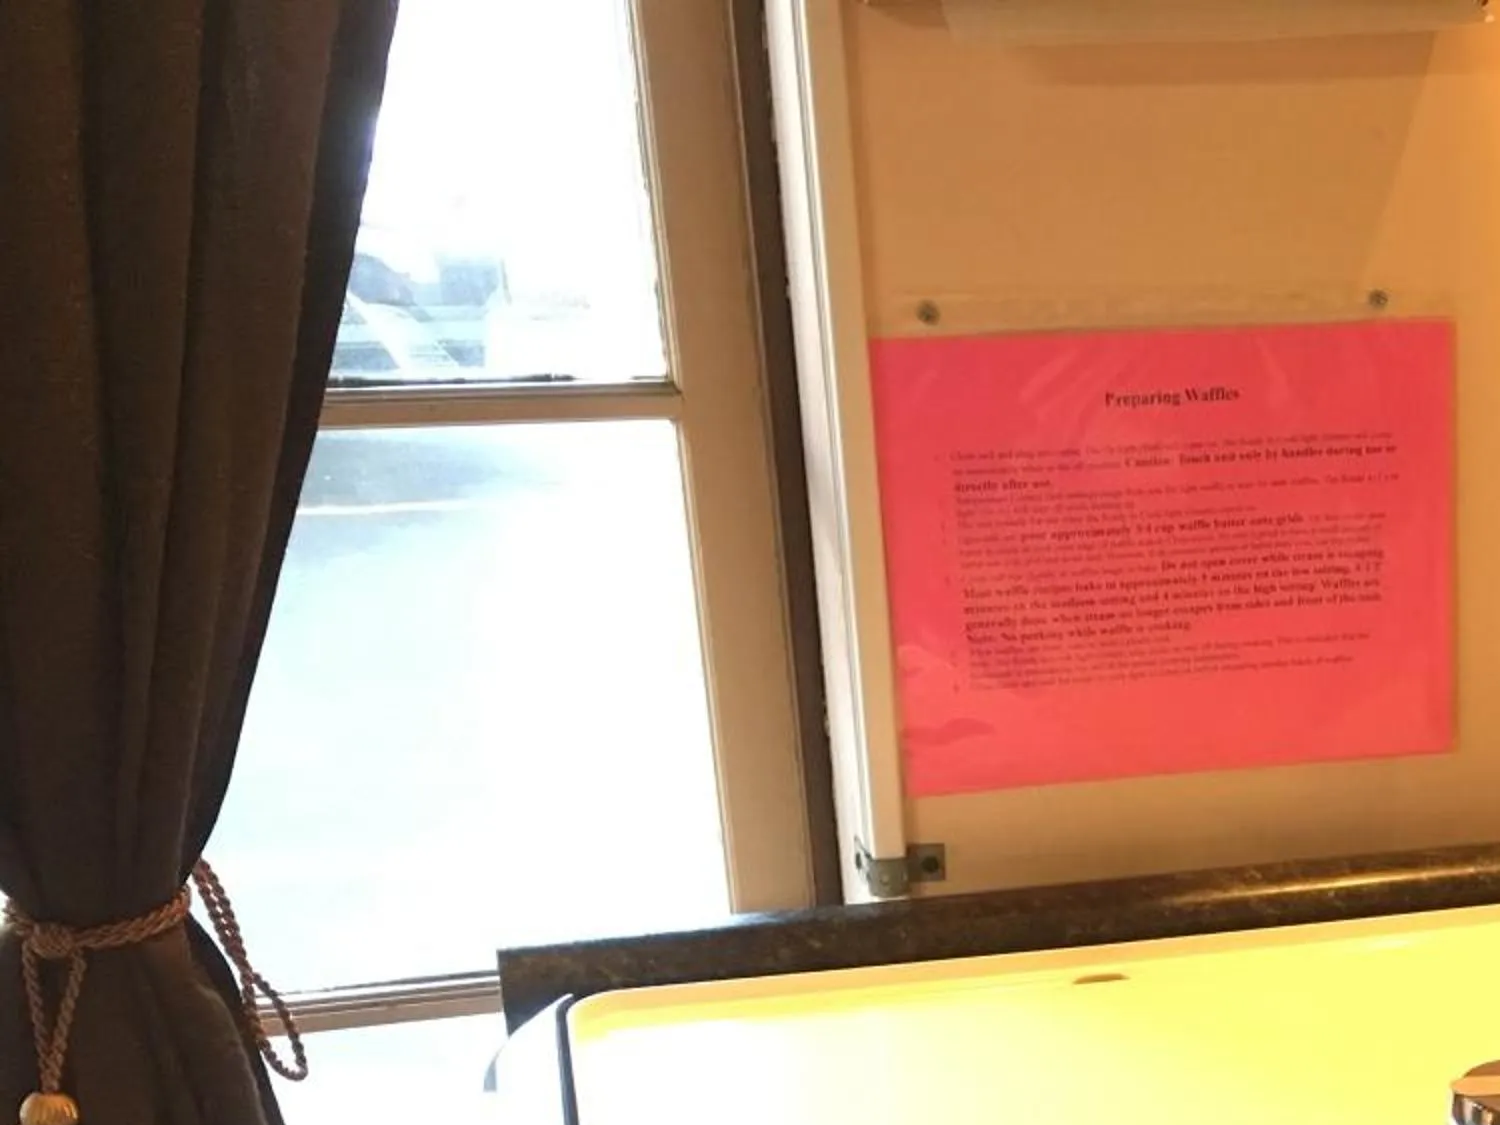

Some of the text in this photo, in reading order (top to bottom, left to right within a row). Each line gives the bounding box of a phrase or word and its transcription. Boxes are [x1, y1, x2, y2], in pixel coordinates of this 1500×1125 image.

[1105, 386, 1241, 408] Preparing Waffles
[1179, 520, 1211, 532] waffle
[1261, 551, 1290, 563] while
[1253, 583, 1277, 596] high
[1320, 577, 1360, 590] Waffles
[1274, 597, 1293, 608] and
[1067, 627, 1097, 639] while
